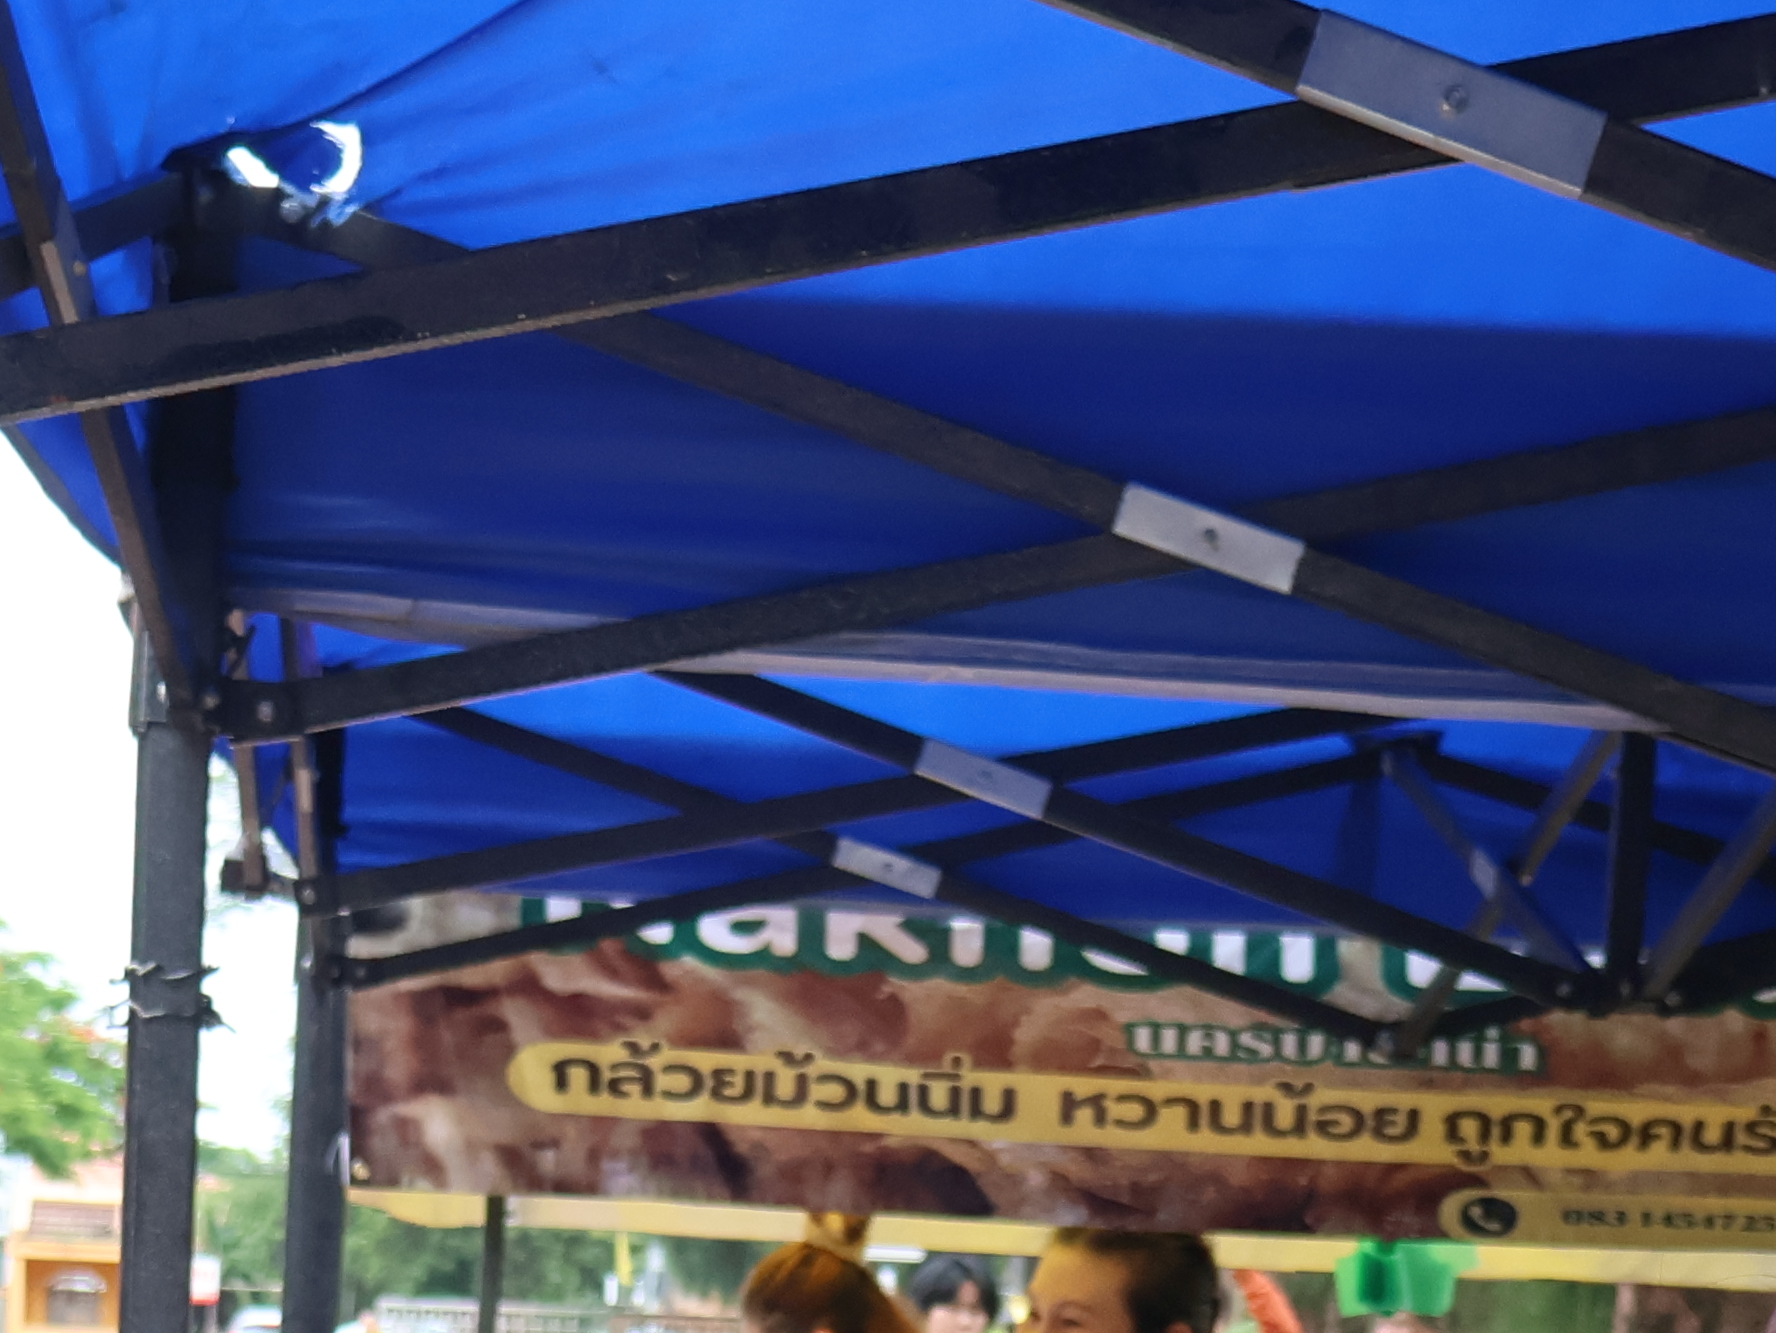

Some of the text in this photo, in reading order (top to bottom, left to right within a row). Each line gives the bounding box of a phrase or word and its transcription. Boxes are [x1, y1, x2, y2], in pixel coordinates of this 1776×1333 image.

[551, 1039, 1020, 1126] กล้วยม้วนนิ่ม
[1059, 1081, 1421, 1143] หวานน้อย
